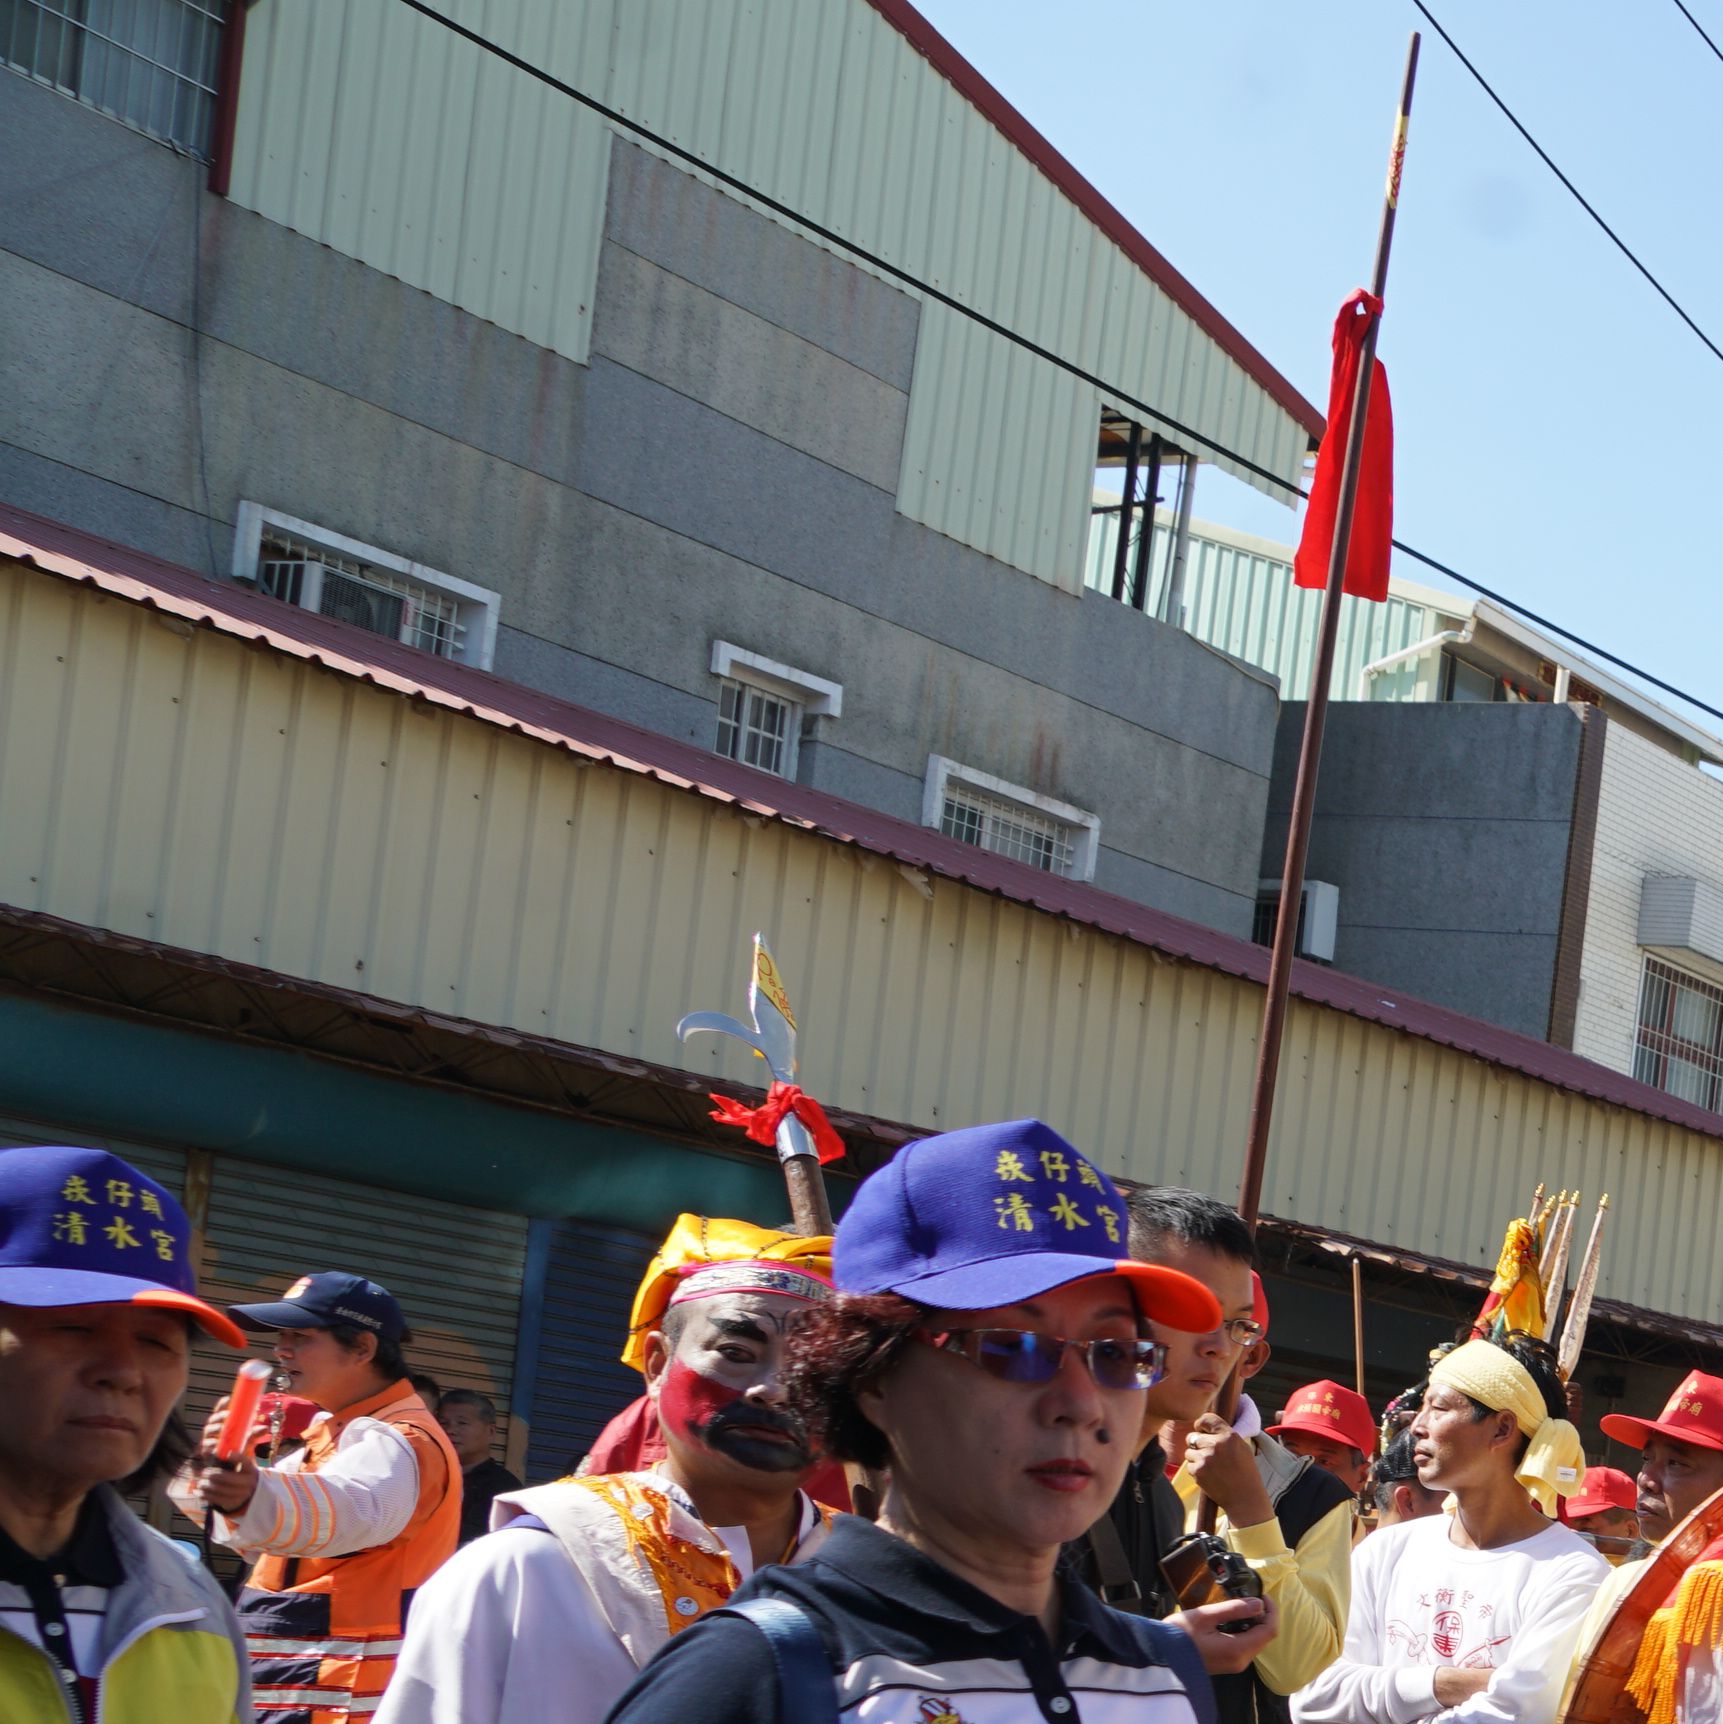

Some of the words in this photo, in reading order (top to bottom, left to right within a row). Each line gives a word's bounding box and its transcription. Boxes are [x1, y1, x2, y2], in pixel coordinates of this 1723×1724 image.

[51, 1210, 177, 1262] 清水宮
[992, 1191, 1121, 1244] 清水宮
